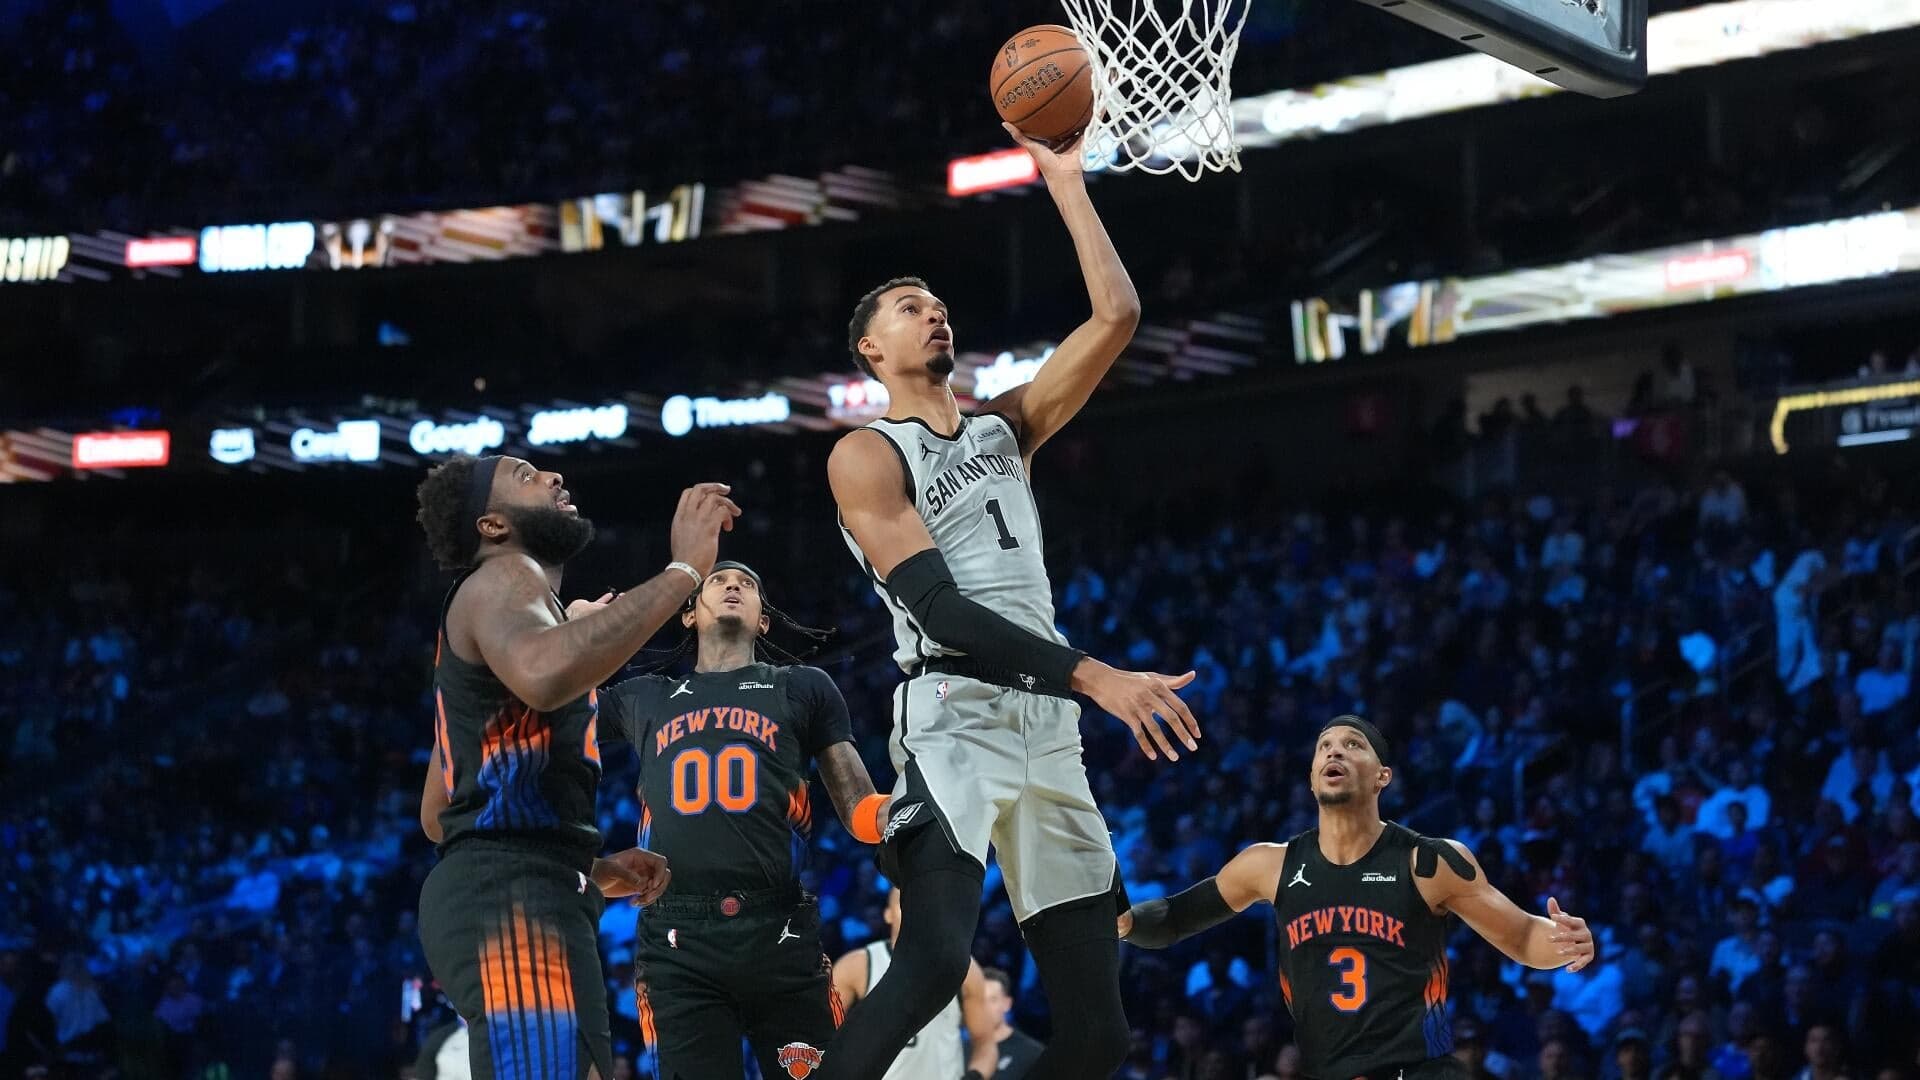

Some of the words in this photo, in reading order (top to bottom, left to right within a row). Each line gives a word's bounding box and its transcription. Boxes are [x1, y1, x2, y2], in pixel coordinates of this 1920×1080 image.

[1000, 62, 1064, 110] Wilson
[925, 468, 962, 517] SAN
[956, 454, 1022, 485] ANTONI
[984, 498, 1021, 551] 1
[655, 708, 711, 757] NEW
[712, 706, 779, 752] YORK
[670, 744, 759, 816] 00
[1286, 906, 1336, 951] NEW
[1337, 906, 1406, 949] YORK
[1328, 945, 1368, 1013] 3
